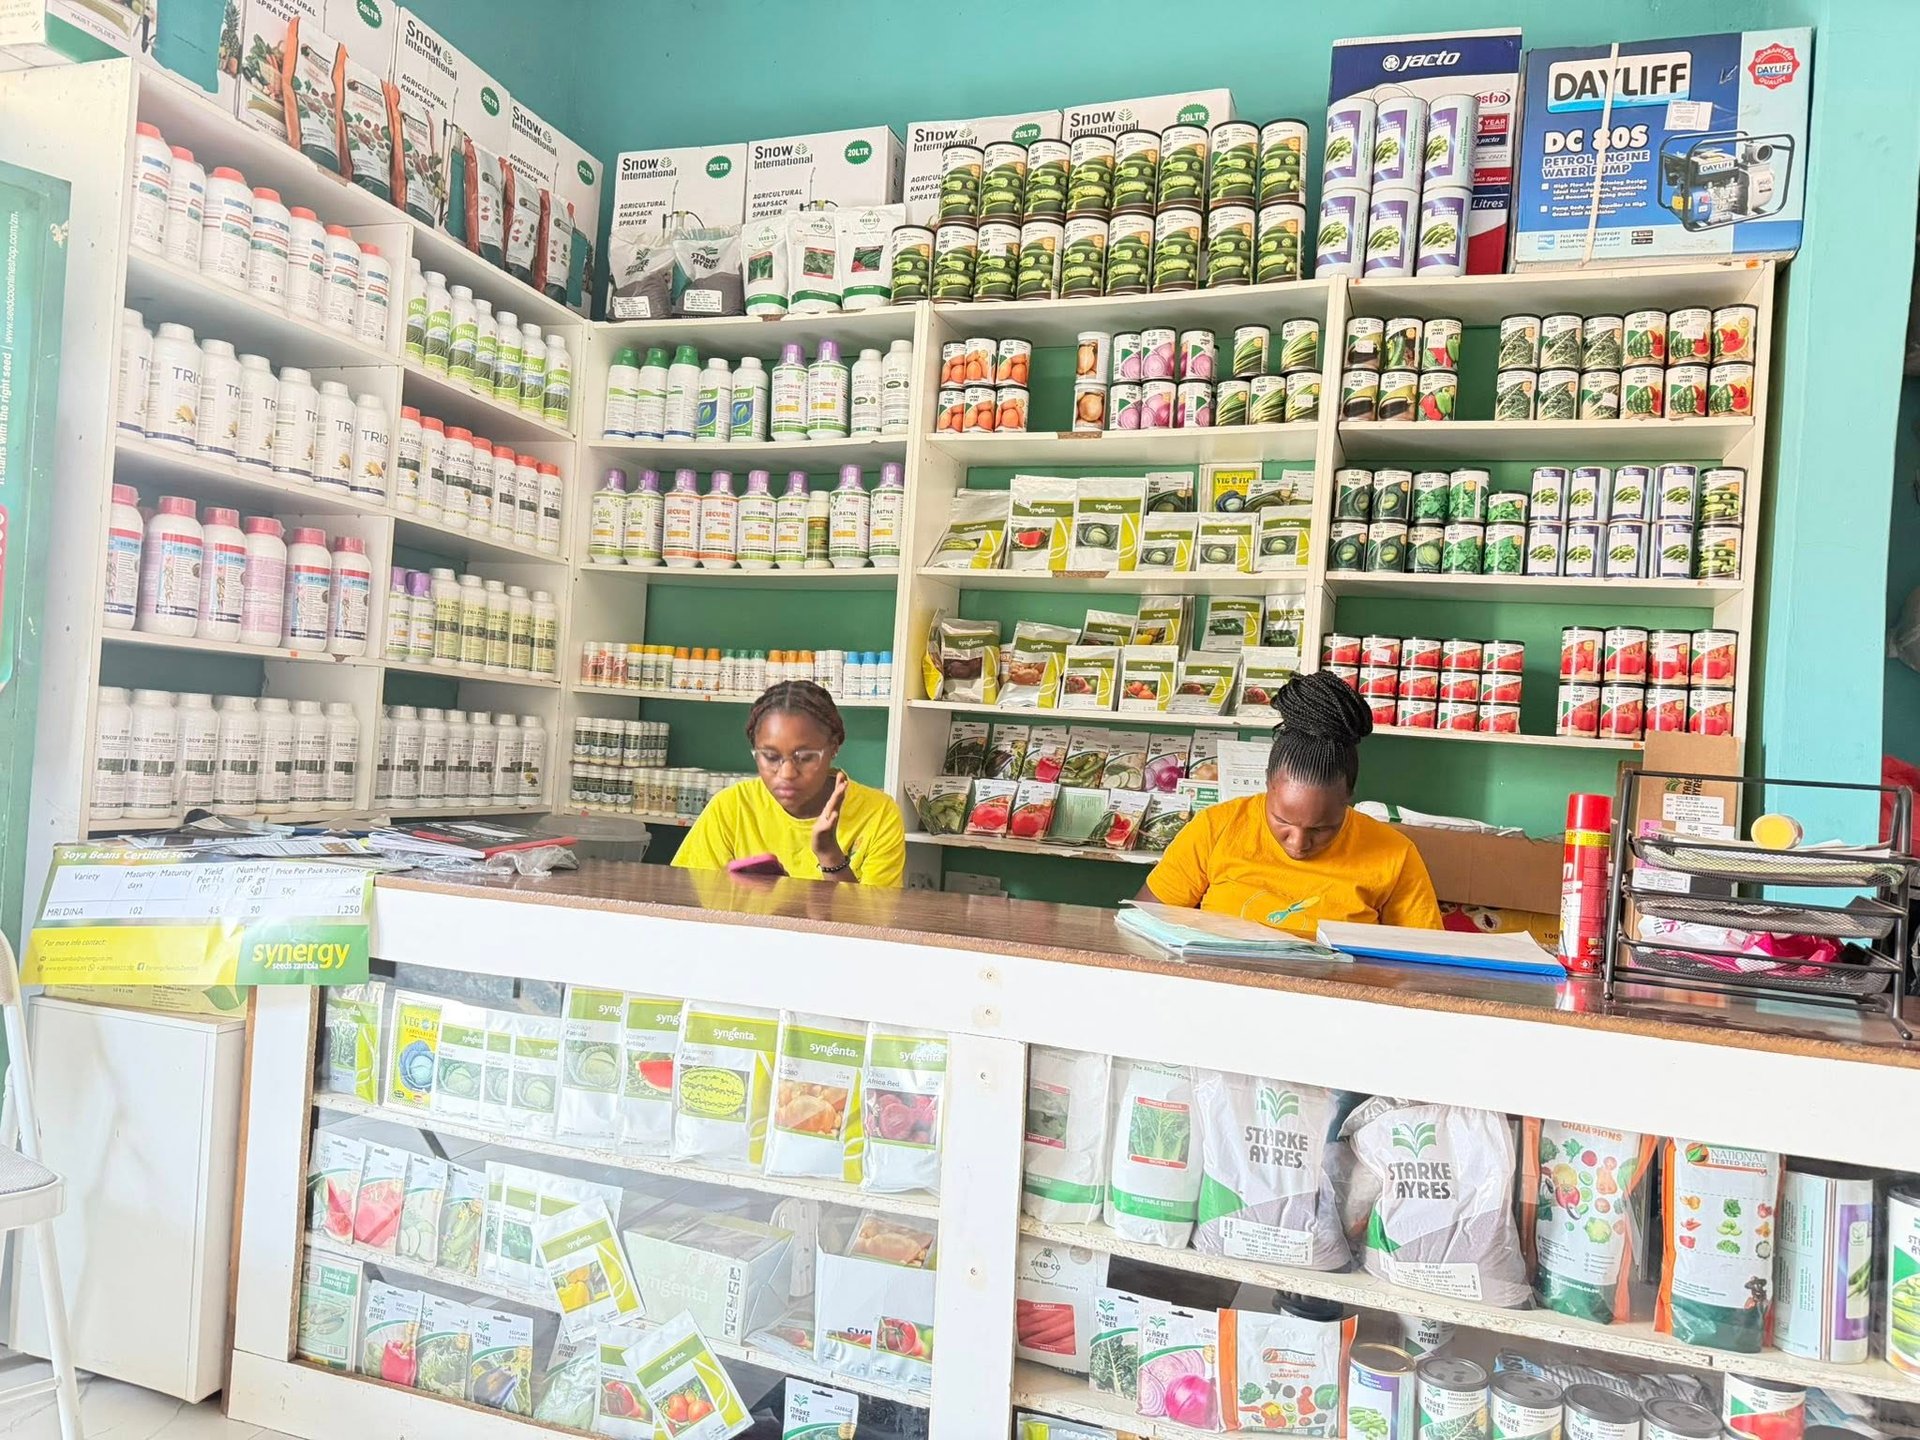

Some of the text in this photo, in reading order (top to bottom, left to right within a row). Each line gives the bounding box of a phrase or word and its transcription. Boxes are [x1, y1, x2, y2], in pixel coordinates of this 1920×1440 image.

[256, 0, 291, 23] SPRAYE
[406, 20, 442, 56] Snow
[405, 34, 458, 81] International
[1757, 65, 1791, 73] DAYLIFF
[1553, 63, 1687, 101] DAYLIFF
[400, 83, 435, 110] KNAPSACK
[402, 73, 448, 110] AGRICULTURAL
[512, 105, 542, 136] Snow
[1070, 111, 1116, 128] Snow
[1179, 112, 1206, 122] 20LTR
[915, 128, 958, 143] Snow
[1014, 128, 1038, 139] 20LTR
[1069, 120, 1140, 138] International
[511, 119, 557, 157] International
[1544, 129, 1583, 153] DC
[913, 137, 978, 153] International
[755, 145, 793, 160] Snow
[847, 147, 869, 157] 20LTR
[622, 158, 659, 172] Snow
[754, 154, 813, 170] International
[1544, 152, 1649, 166] PETROL NGINE
[509, 153, 550, 183] AGRICULTURAL
[708, 162, 728, 172] 20LTR
[1543, 167, 1586, 178] WATER
[1702, 161, 1733, 173] DAYLIFF
[621, 167, 677, 181] International
[910, 173, 944, 183] AGRICUL
[752, 188, 803, 200] AGRICULTURAL
[910, 183, 942, 193] KNAPSA
[909, 192, 941, 202] SPRAYE
[619, 200, 666, 210] AGRICULTURAL
[752, 199, 788, 209] KNAPSACK
[1472, 199, 1504, 209] Litres
[619, 210, 653, 218] KNAPSACK
[752, 209, 783, 218] SPRAYER
[618, 219, 647, 227] SPRAYER
[2, 352, 12, 377] seed
[62, 851, 87, 861] Soya
[90, 851, 120, 859] Beans
[123, 851, 168, 860] Certified
[74, 872, 100, 882] Variety
[125, 870, 156, 879] Maturity
[160, 869, 193, 878] Maturity
[204, 867, 223, 875] Yield
[236, 866, 270, 874] Number
[46, 908, 63, 916] MRI
[63, 908, 83, 916] DINA
[337, 905, 360, 915] 1,250
[252, 941, 350, 970] synergy
[272, 962, 292, 970] seeds
[599, 1004, 622, 1015] syng
[656, 1013, 682, 1025] syng
[1245, 1126, 1309, 1151] STARKE
[1250, 1145, 1303, 1168] AYRES
[1711, 1149, 1765, 1162] NATIONAL
[1711, 1158, 1767, 1168] TESTED SEEDS
[1388, 1162, 1451, 1180] STARKE
[1396, 1181, 1450, 1199] AYRES
[1418, 1331, 1439, 1339] STARKE
[1419, 1337, 1439, 1345] AYRES
[1424, 1397, 1445, 1410] STARKE
[789, 1405, 810, 1418] STARKE
[1498, 1412, 1520, 1426] STARKE
